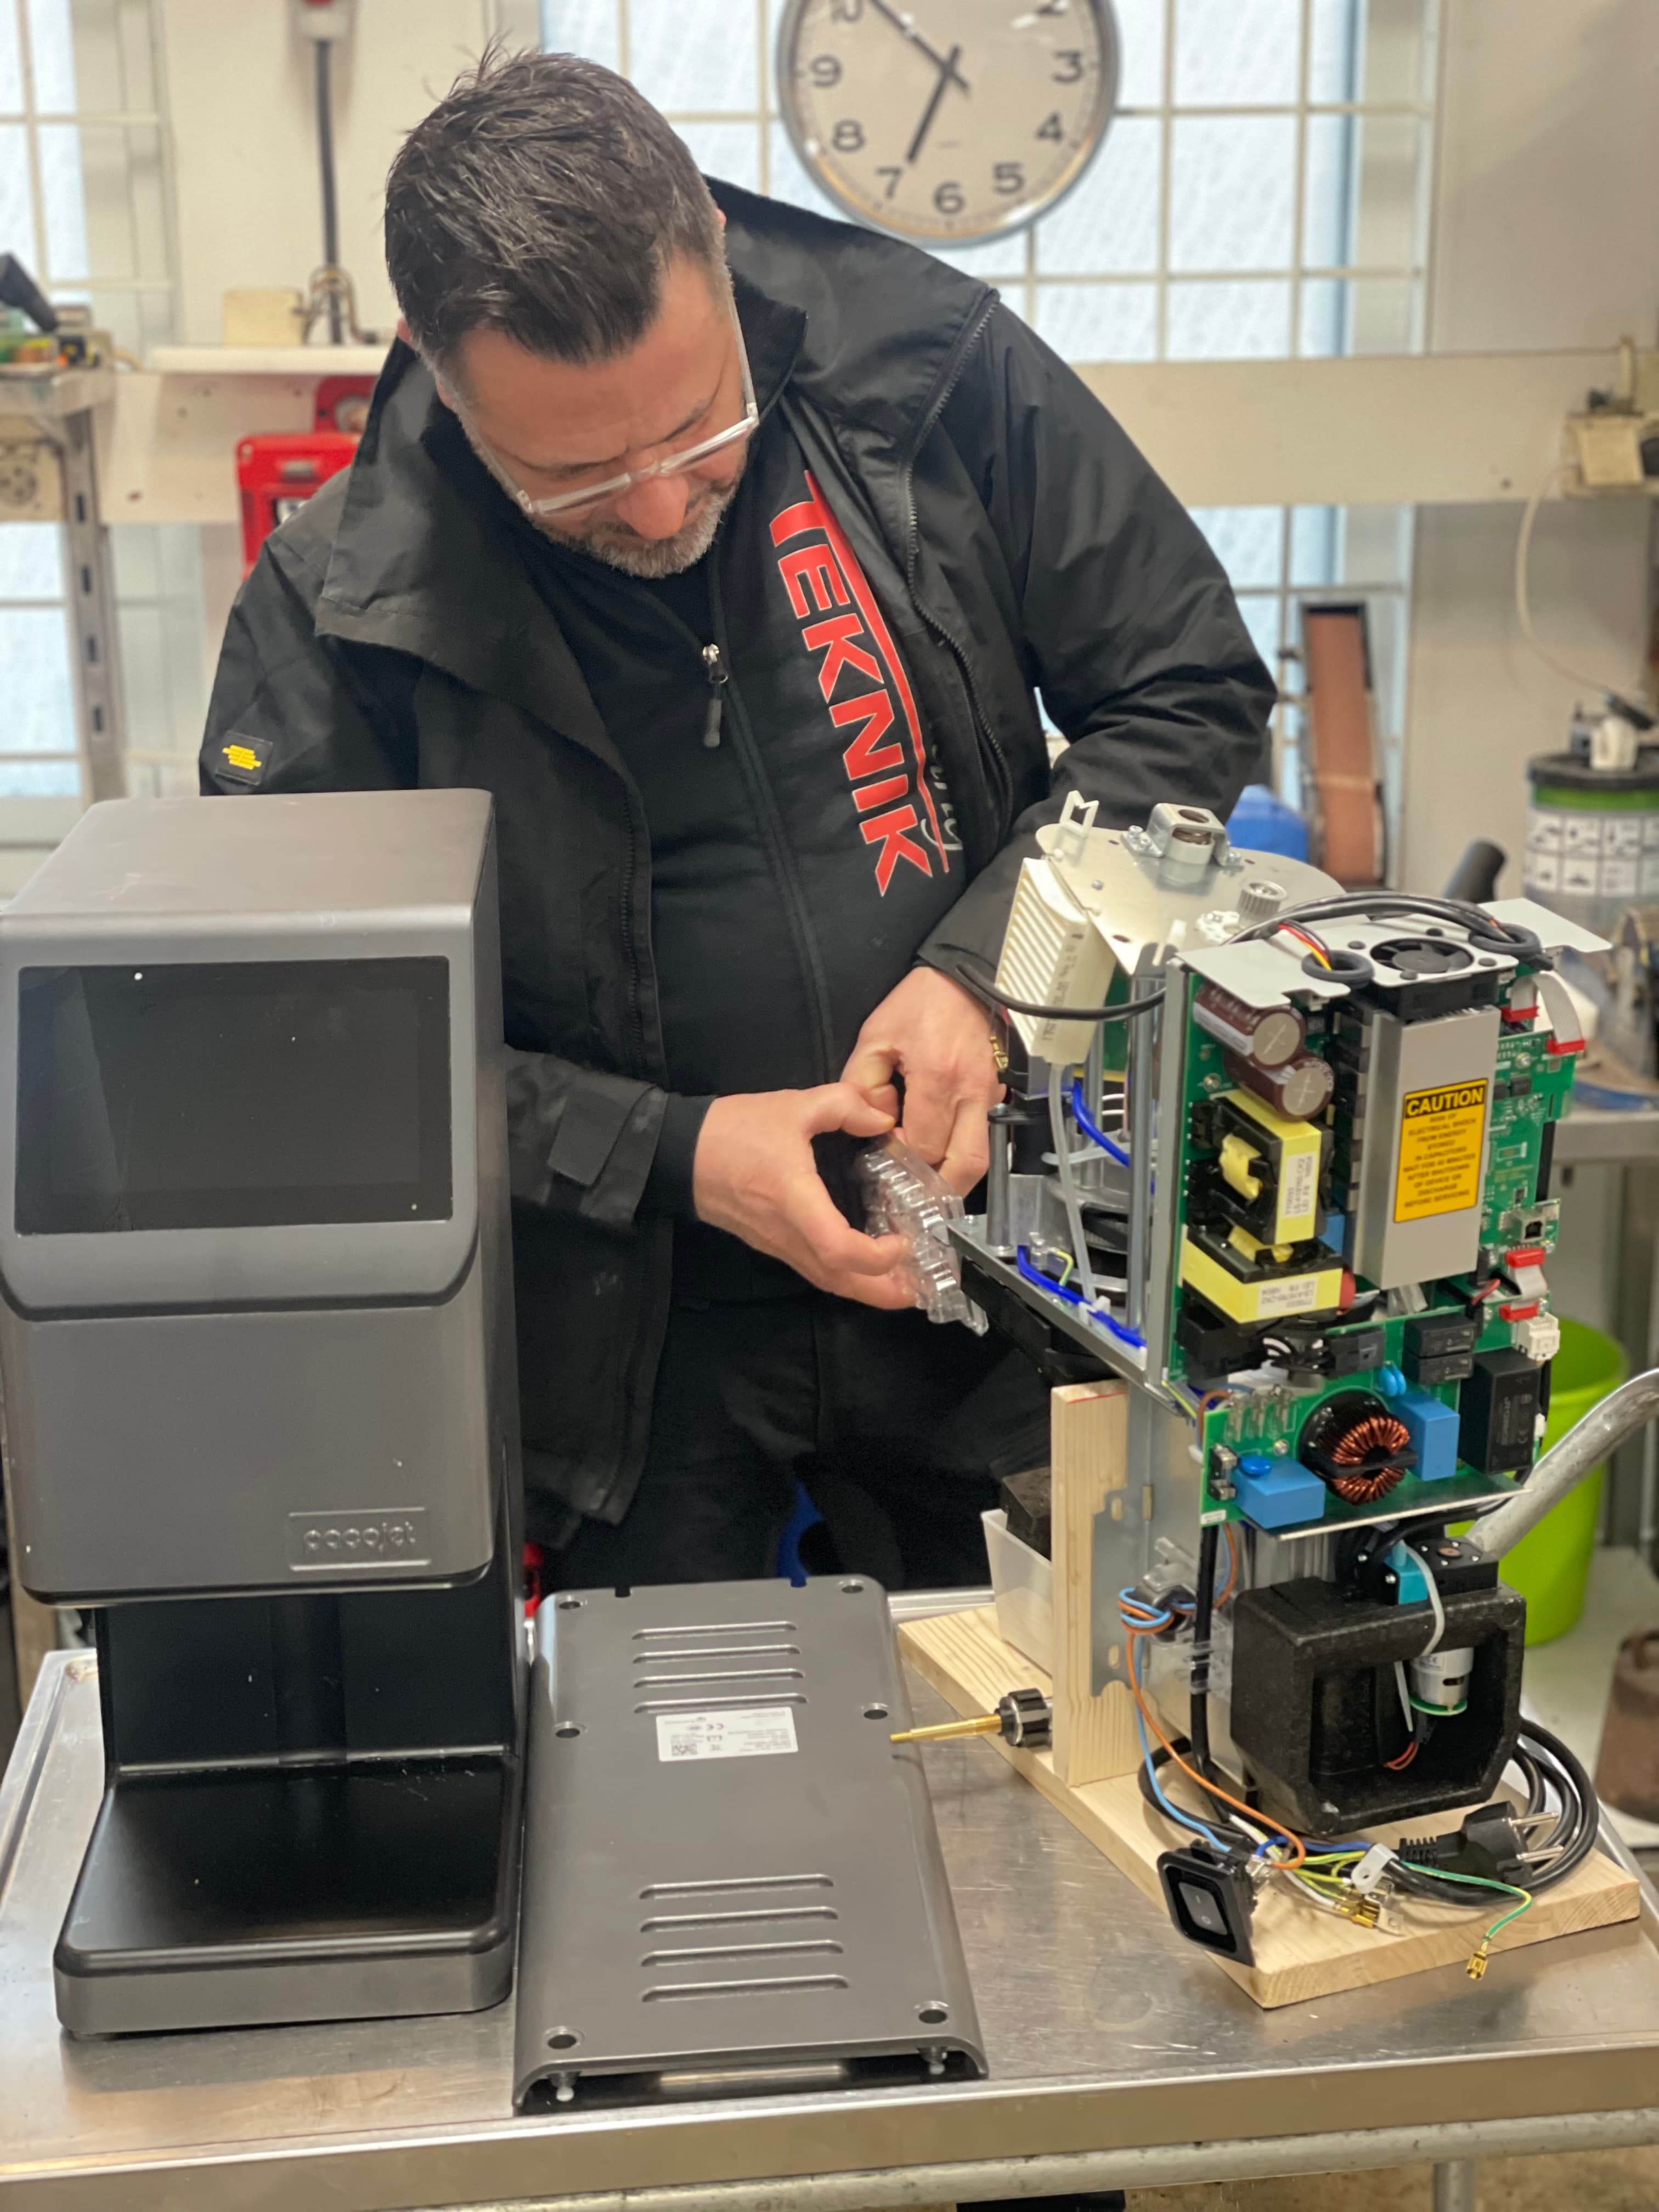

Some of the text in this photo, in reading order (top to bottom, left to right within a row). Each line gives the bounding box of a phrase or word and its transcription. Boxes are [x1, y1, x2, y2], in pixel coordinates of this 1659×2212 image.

[809, 55, 843, 88] 9
[1053, 51, 1084, 84] 3
[832, 120, 865, 152] 8
[1035, 113, 1064, 142] 4
[876, 168, 903, 199] 7
[993, 162, 1024, 195] 5
[934, 183, 964, 214] 6
[770, 483, 933, 897] TEKNIK
[1407, 1087, 1484, 1116] CAUTION
[1408, 1118, 1476, 1136] ELECTRICAL SHOCK
[1417, 1128, 1466, 1143] FROM ENERGY
[1447, 1153, 1476, 1164] MINUTES
[1407, 1171, 1429, 1181] AFTER
[1404, 1189, 1470, 1208] BEFORE SERVICING
